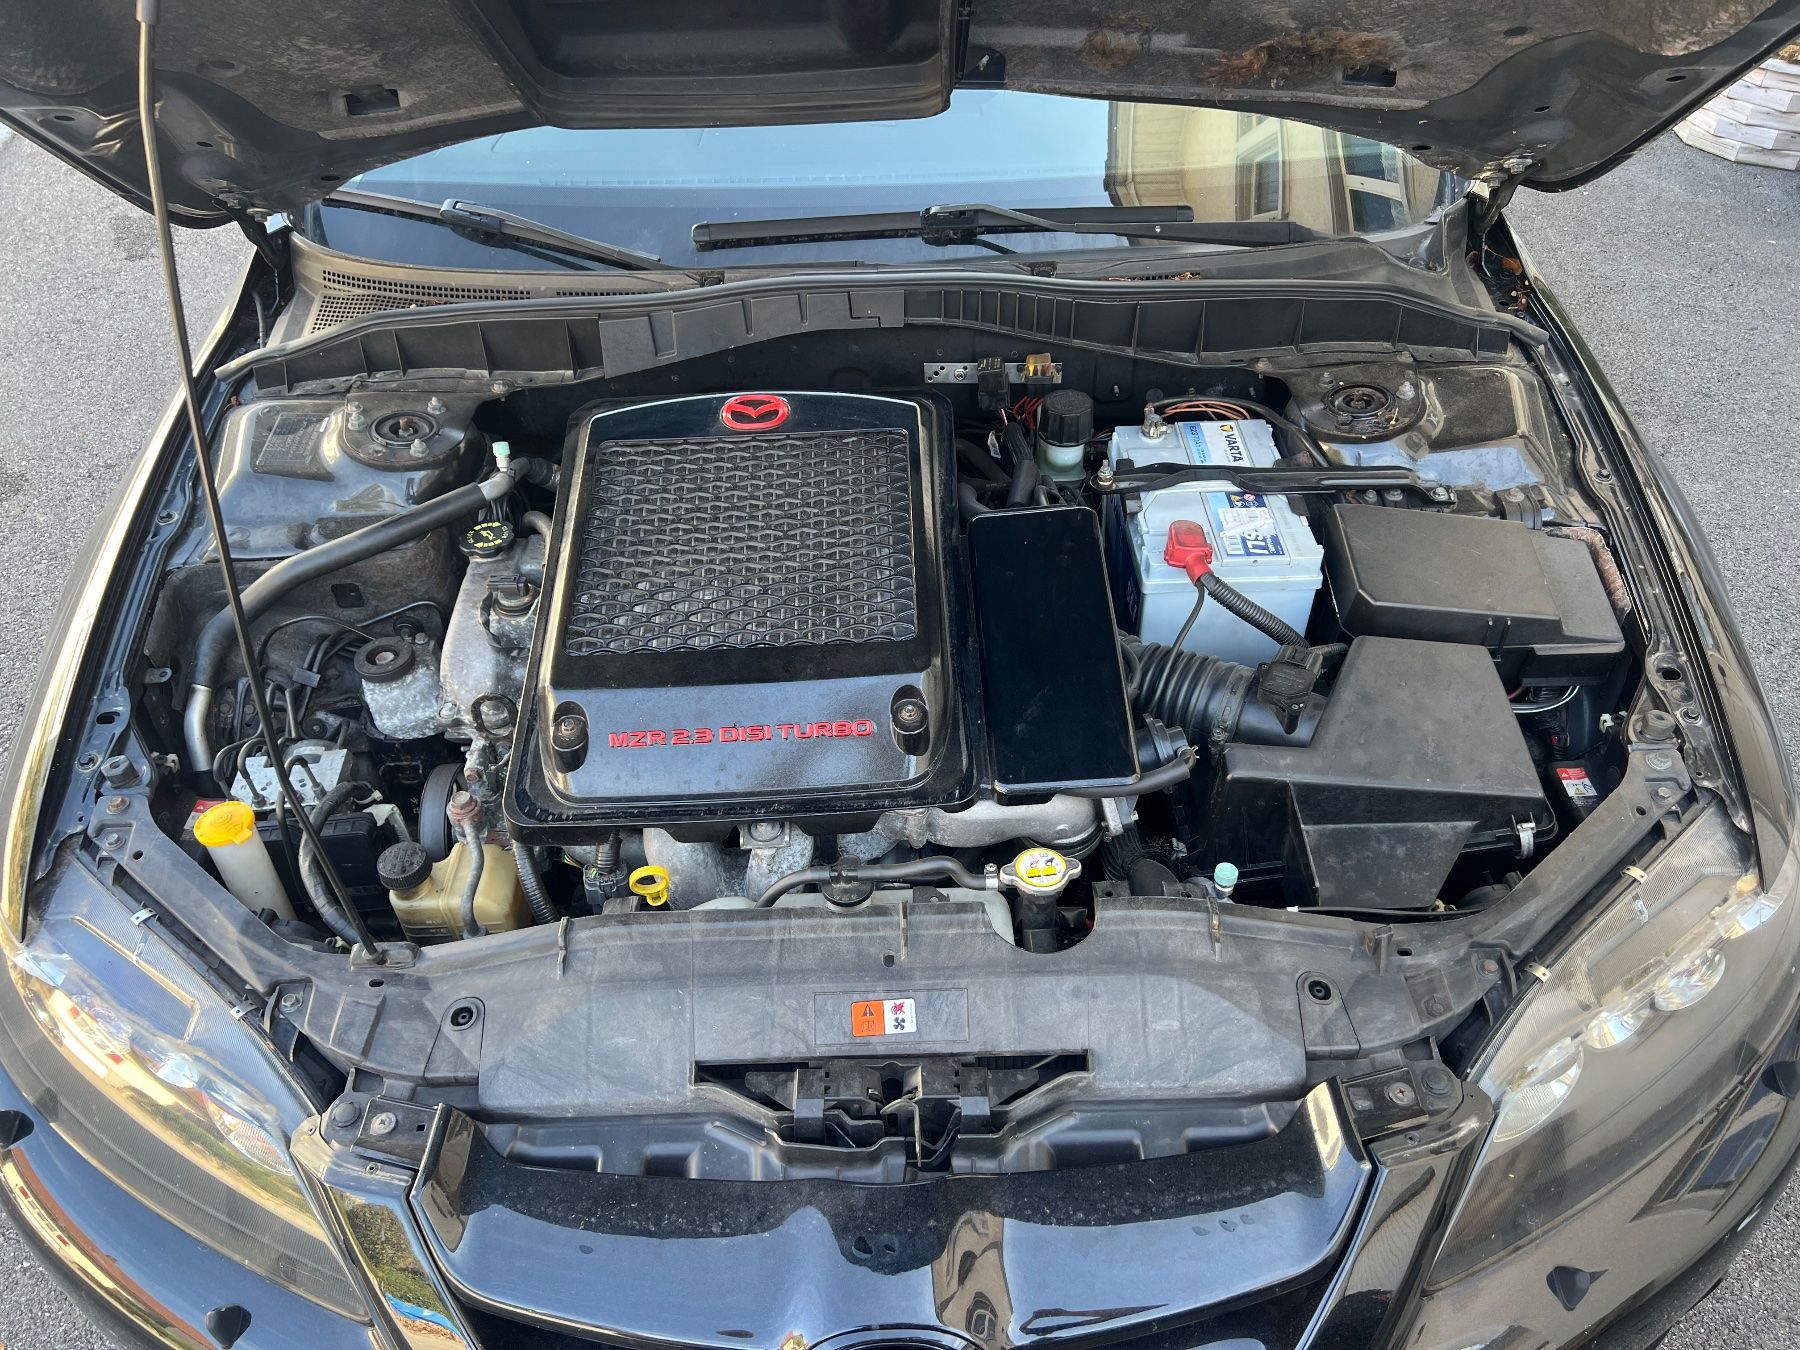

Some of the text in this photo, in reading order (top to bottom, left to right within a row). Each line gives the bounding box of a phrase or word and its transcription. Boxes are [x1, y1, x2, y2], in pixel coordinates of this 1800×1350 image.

[1189, 425, 1199, 437] E23
[1224, 434, 1244, 463] VARTA
[608, 719, 873, 749] MZR 2.3 DISI TURBO
